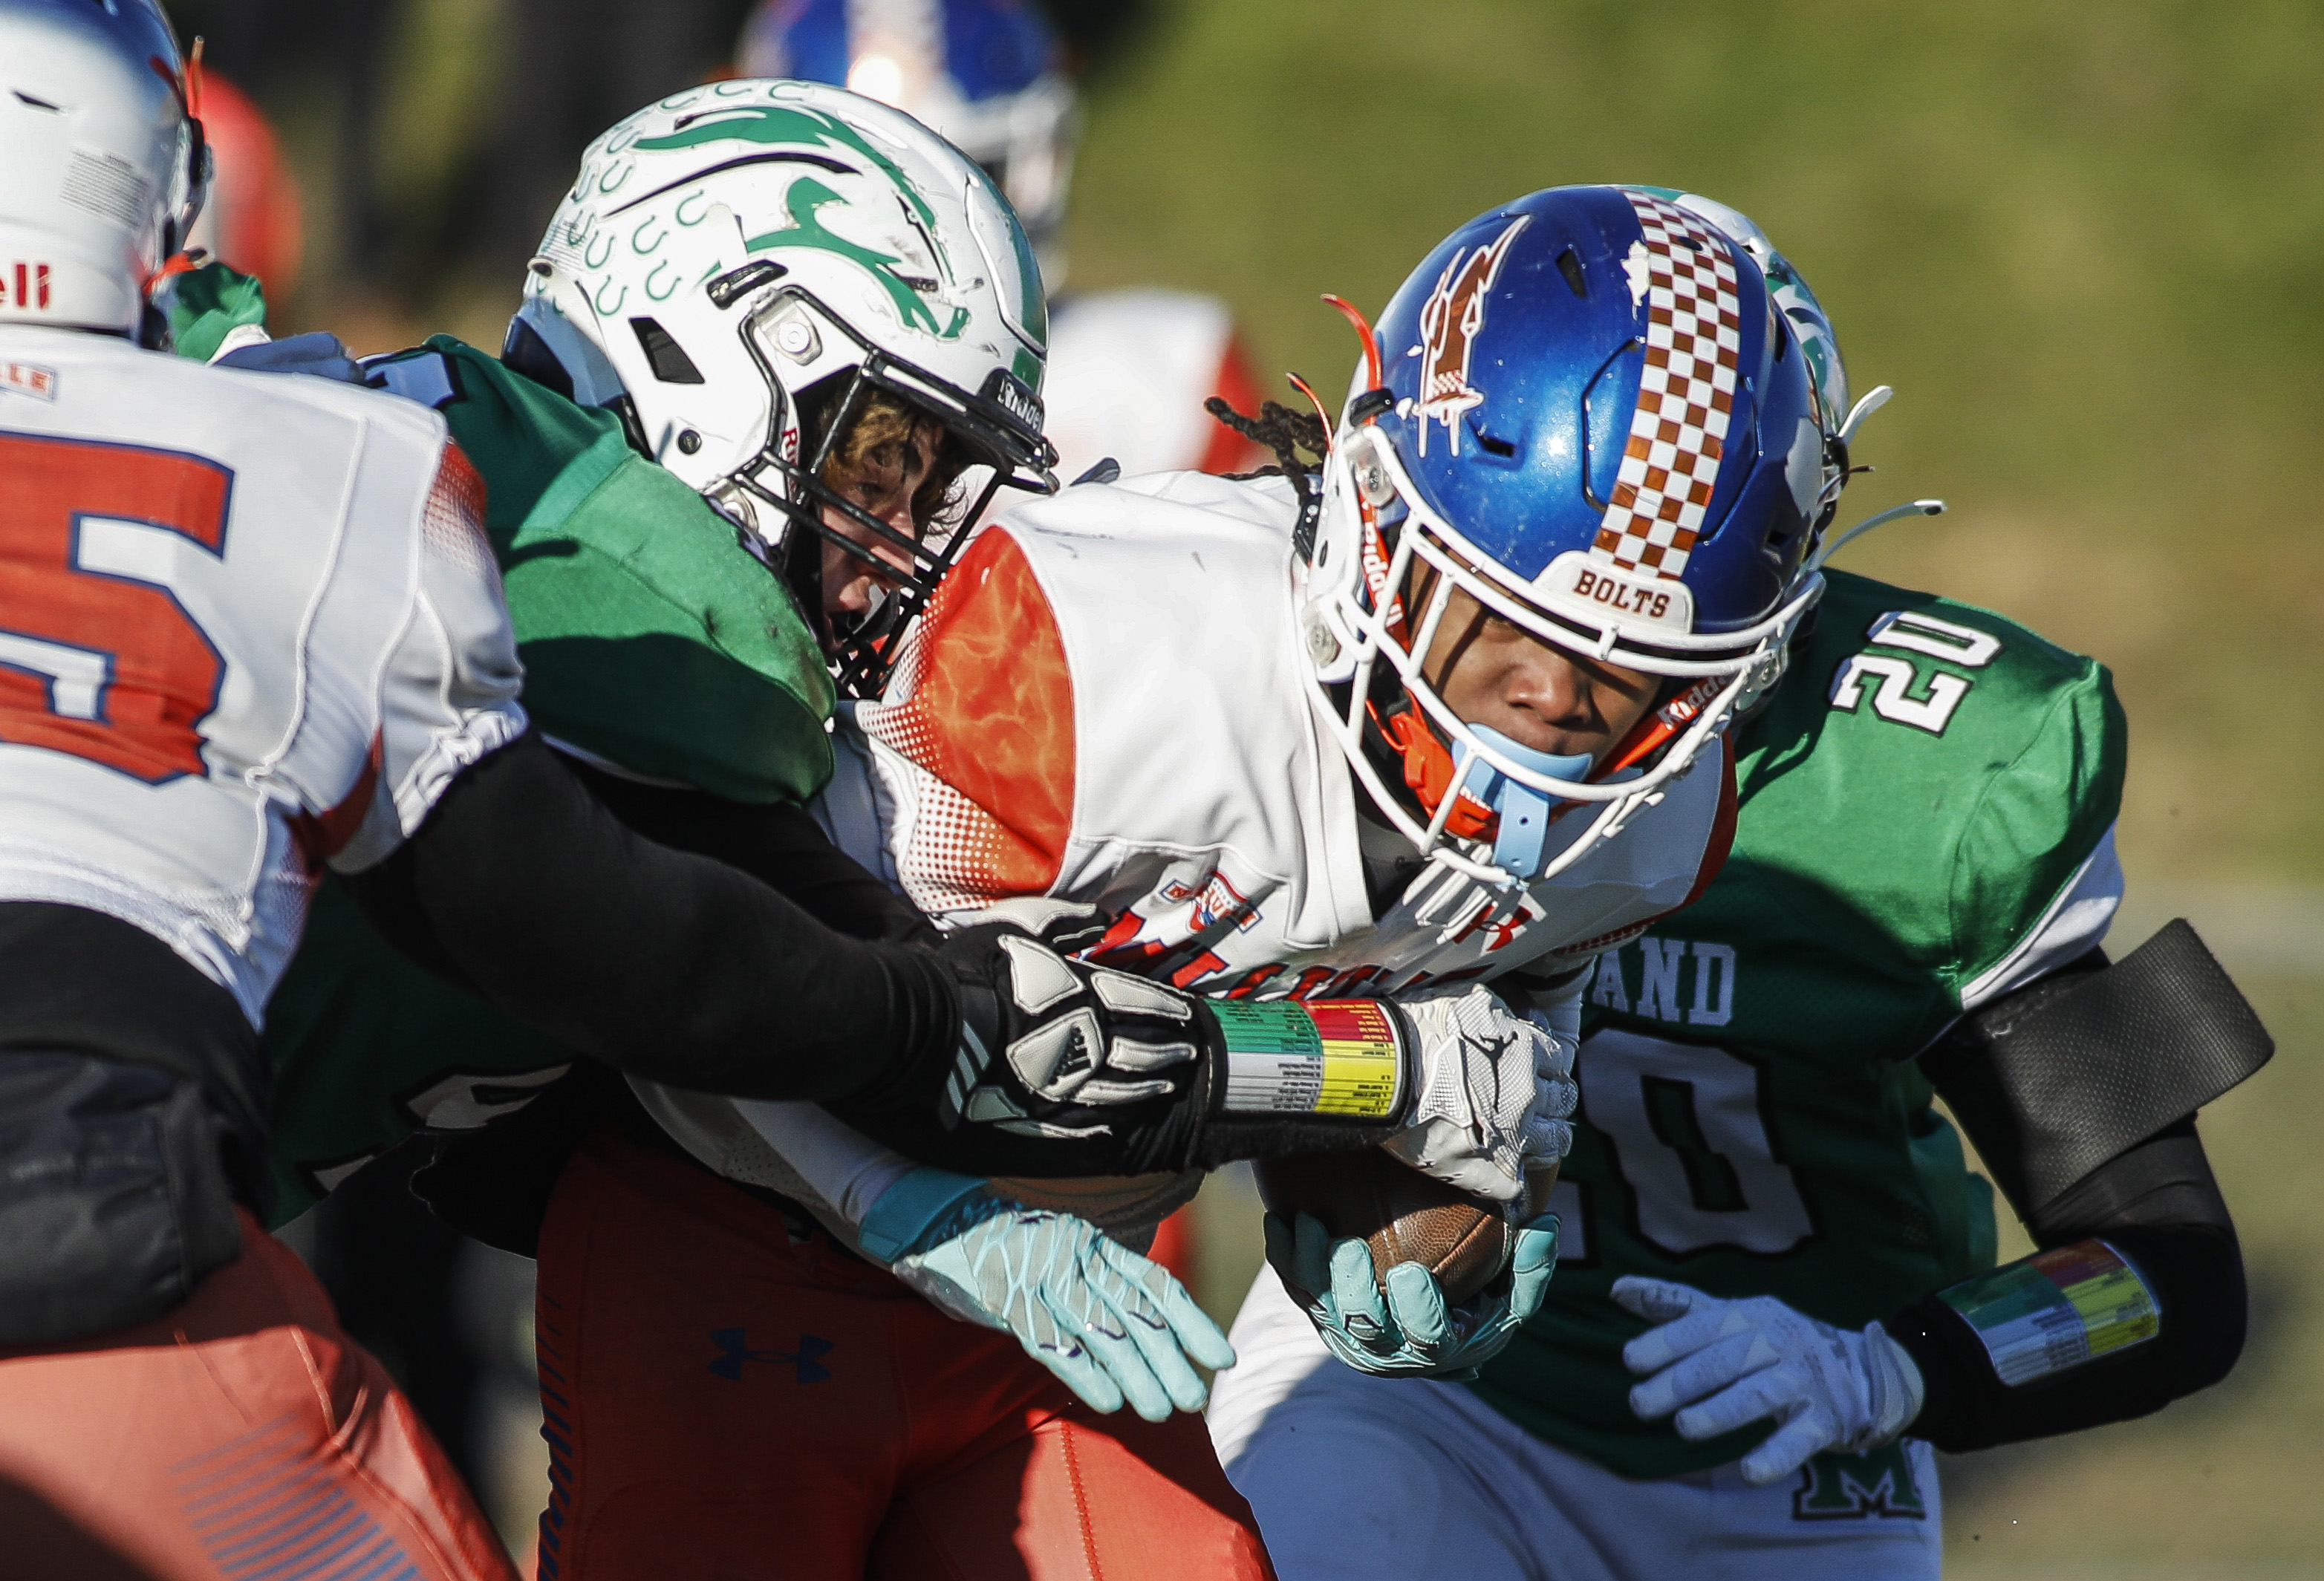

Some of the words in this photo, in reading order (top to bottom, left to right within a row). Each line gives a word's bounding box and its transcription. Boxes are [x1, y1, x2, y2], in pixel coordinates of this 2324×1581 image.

[1574, 570, 1670, 617] BOLTS
[1828, 610, 2003, 737] 20
[1545, 1028, 1815, 1255] 0
